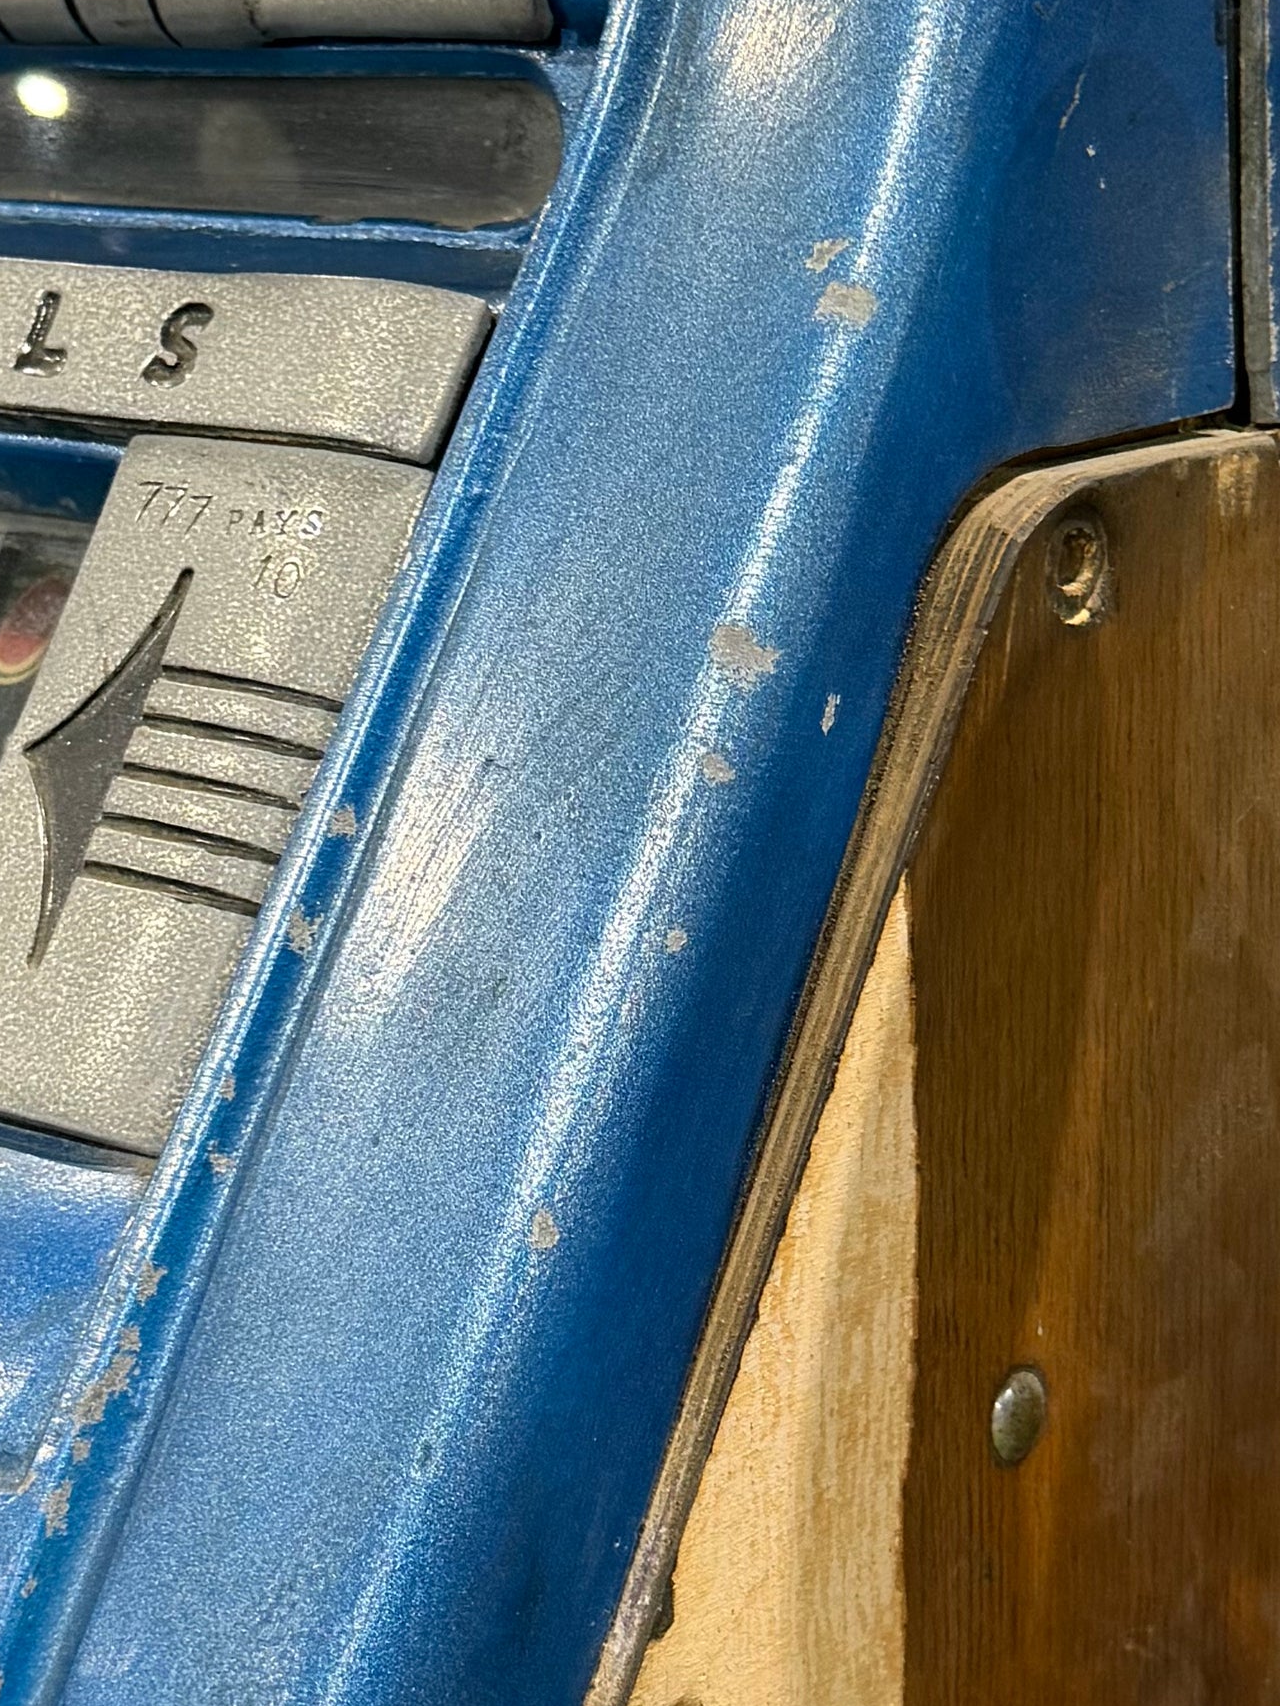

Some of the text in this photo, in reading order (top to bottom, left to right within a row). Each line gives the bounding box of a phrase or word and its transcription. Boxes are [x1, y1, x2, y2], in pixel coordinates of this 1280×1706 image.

[135, 480, 326, 537] 777 PAYS
[253, 555, 302, 599] 10
